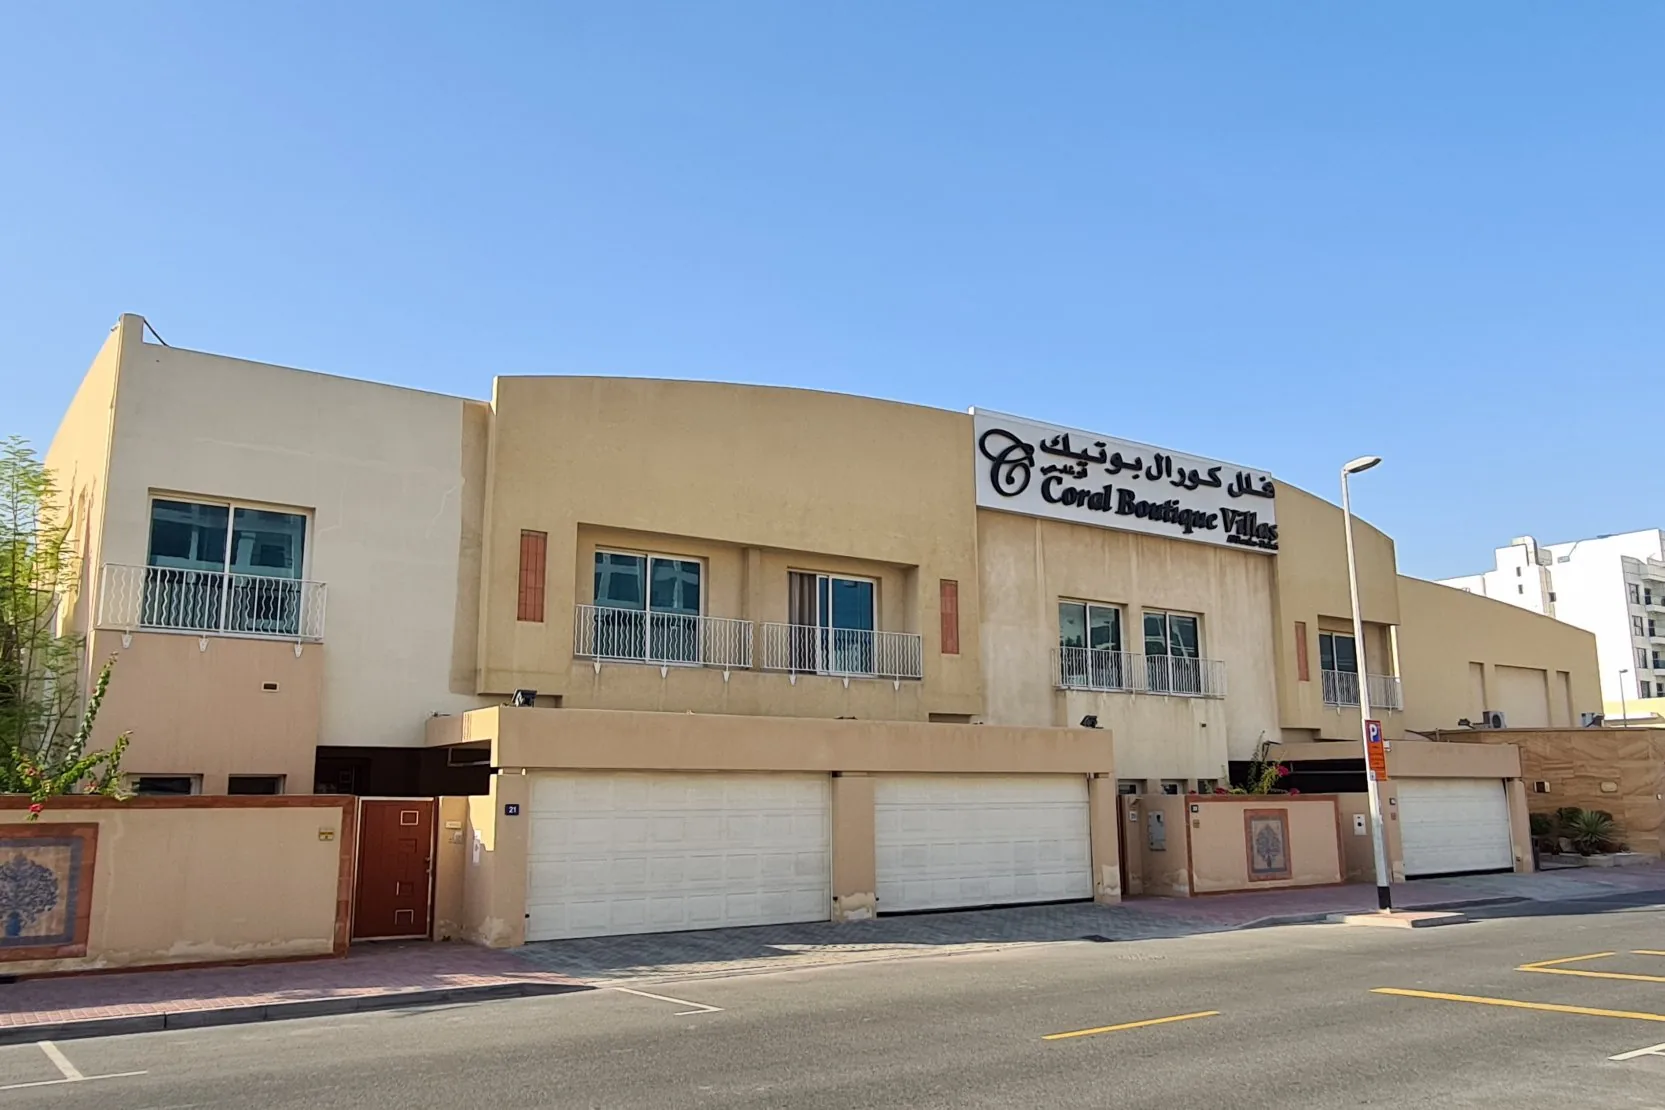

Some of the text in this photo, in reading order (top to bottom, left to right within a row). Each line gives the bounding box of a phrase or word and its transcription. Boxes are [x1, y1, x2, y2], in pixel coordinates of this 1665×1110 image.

[1039, 432, 1143, 480] بوتيك
[1145, 453, 1222, 491] كورال
[1227, 470, 1275, 498] فلل
[1041, 475, 1279, 541] Coral Boutique Villas
[1369, 723, 1378, 742] P
[508, 806, 517, 814] 21
